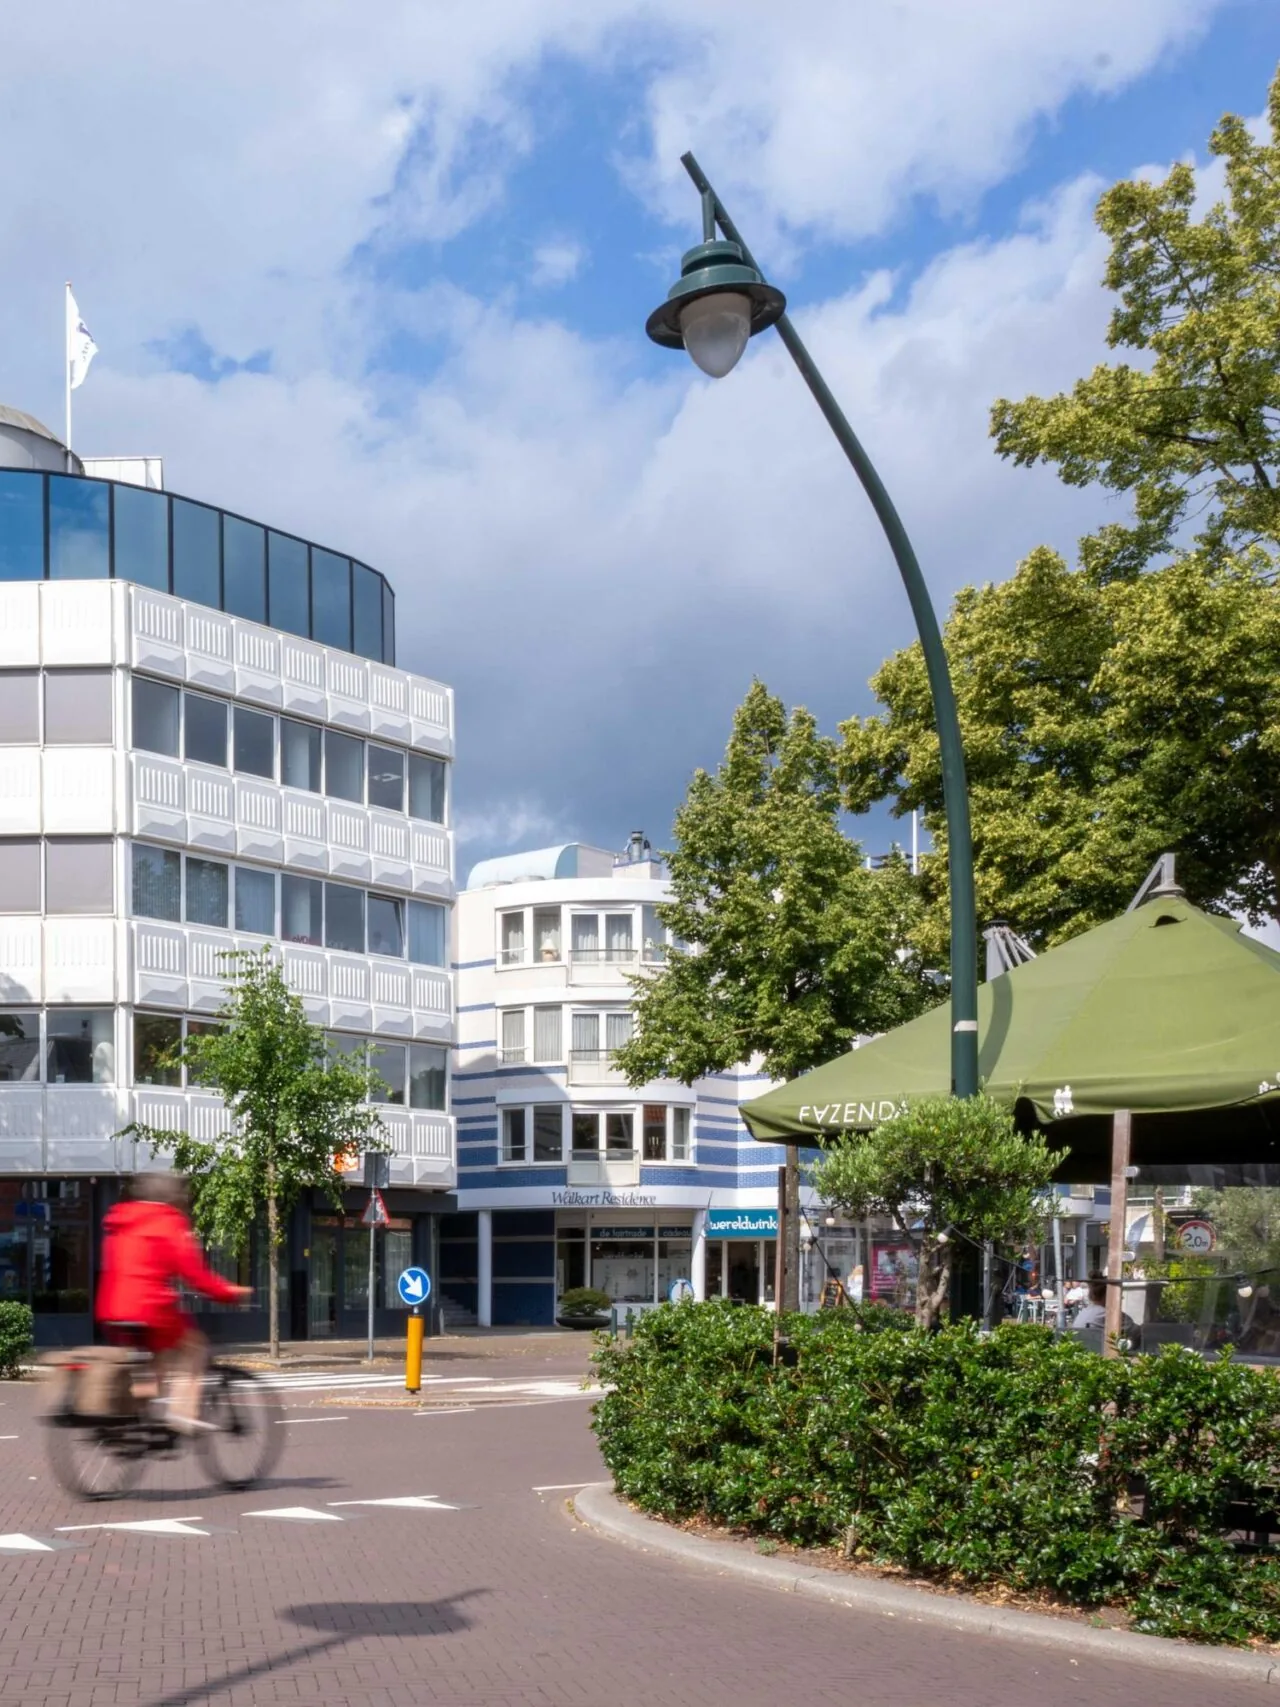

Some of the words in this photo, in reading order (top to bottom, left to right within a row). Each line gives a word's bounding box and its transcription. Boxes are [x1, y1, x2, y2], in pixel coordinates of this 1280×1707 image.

[552, 1191, 599, 1205] Walkart
[601, 1191, 656, 1206] Residence
[710, 1215, 778, 1230] wereldwink
